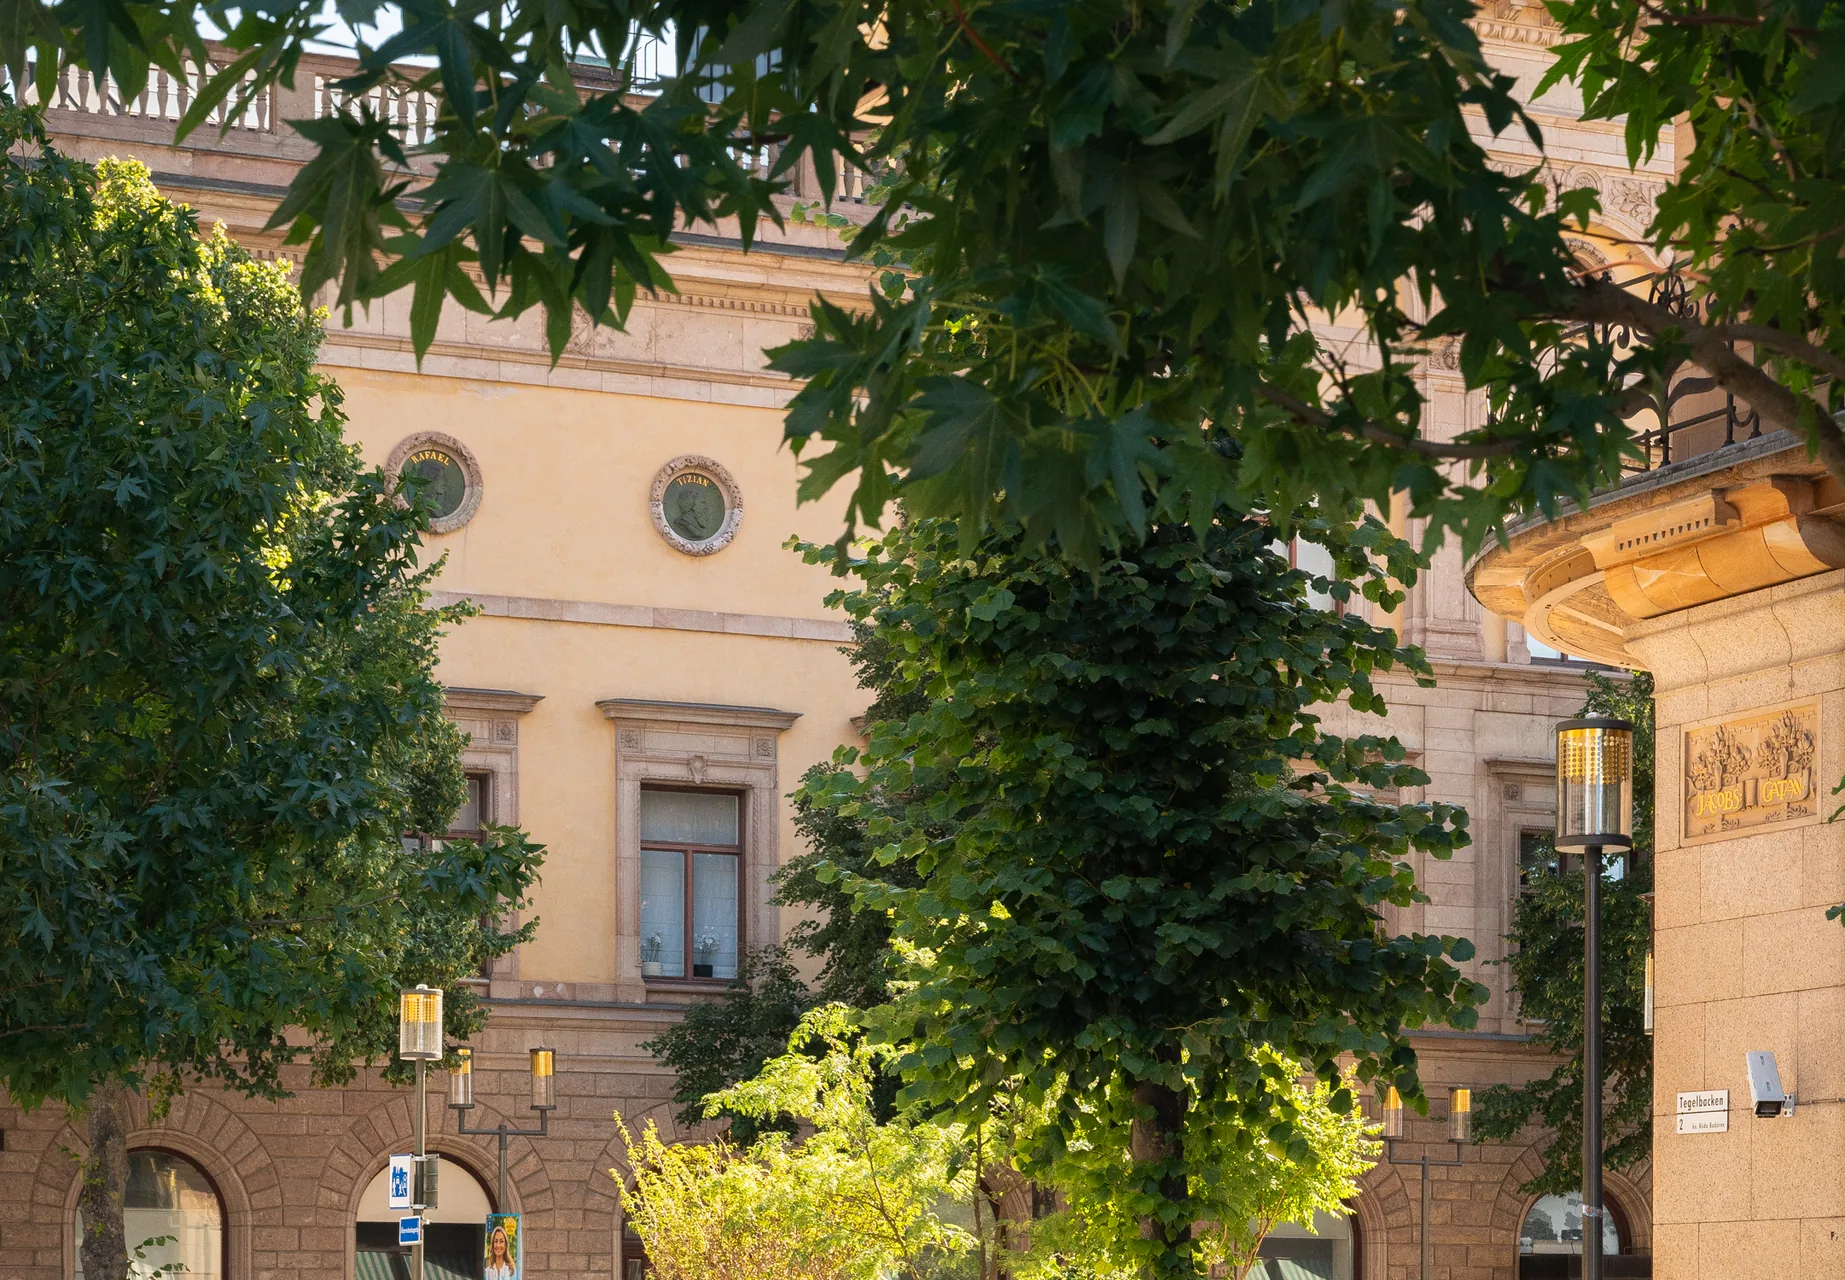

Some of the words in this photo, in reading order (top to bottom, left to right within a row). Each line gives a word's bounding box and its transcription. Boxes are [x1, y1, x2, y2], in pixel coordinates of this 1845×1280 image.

[411, 451, 450, 466] RAFAEL
[676, 475, 709, 487] TIZIAN
[1680, 1094, 1724, 1111] Tegelbacken
[1679, 1119, 1684, 1130] 2
